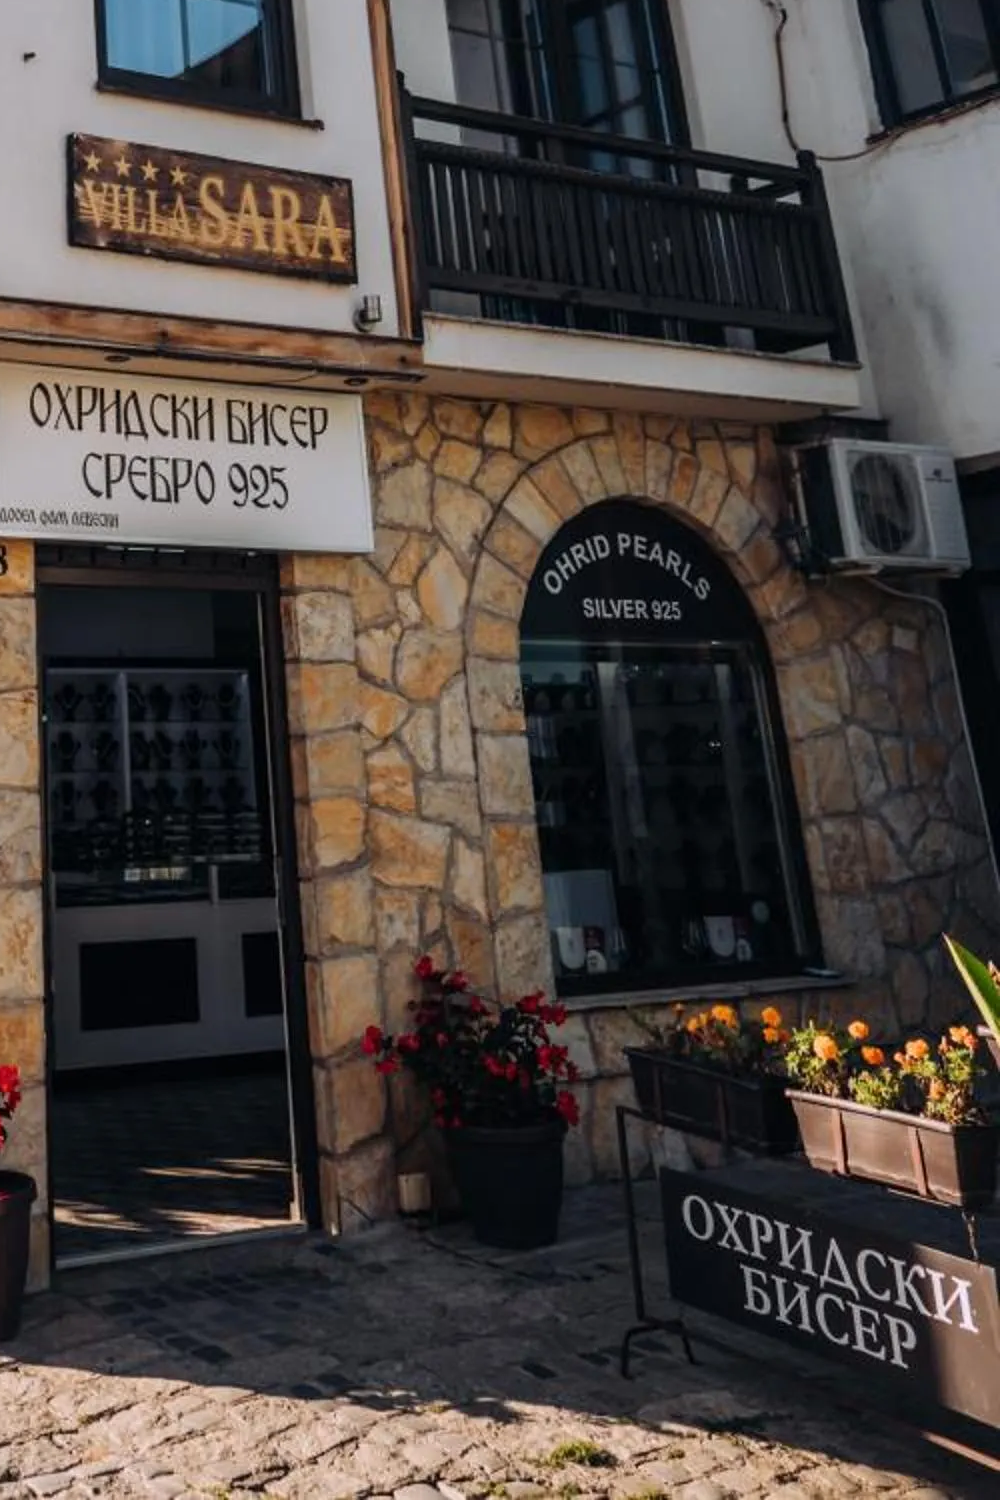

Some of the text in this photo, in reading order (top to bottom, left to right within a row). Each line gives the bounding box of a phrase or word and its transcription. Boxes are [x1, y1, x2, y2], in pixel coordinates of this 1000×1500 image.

[83, 175, 347, 263] VILLA SARA
[29, 382, 328, 449] ОХРИДСКИ БИСЕР
[82, 452, 289, 509] СРЕБРО 925
[543, 532, 711, 601] OHRID PEARLS
[583, 598, 682, 621] SILVER 925
[682, 1195, 979, 1333] ОХРИДСКИ
[740, 1264, 917, 1369] БИСЕР
